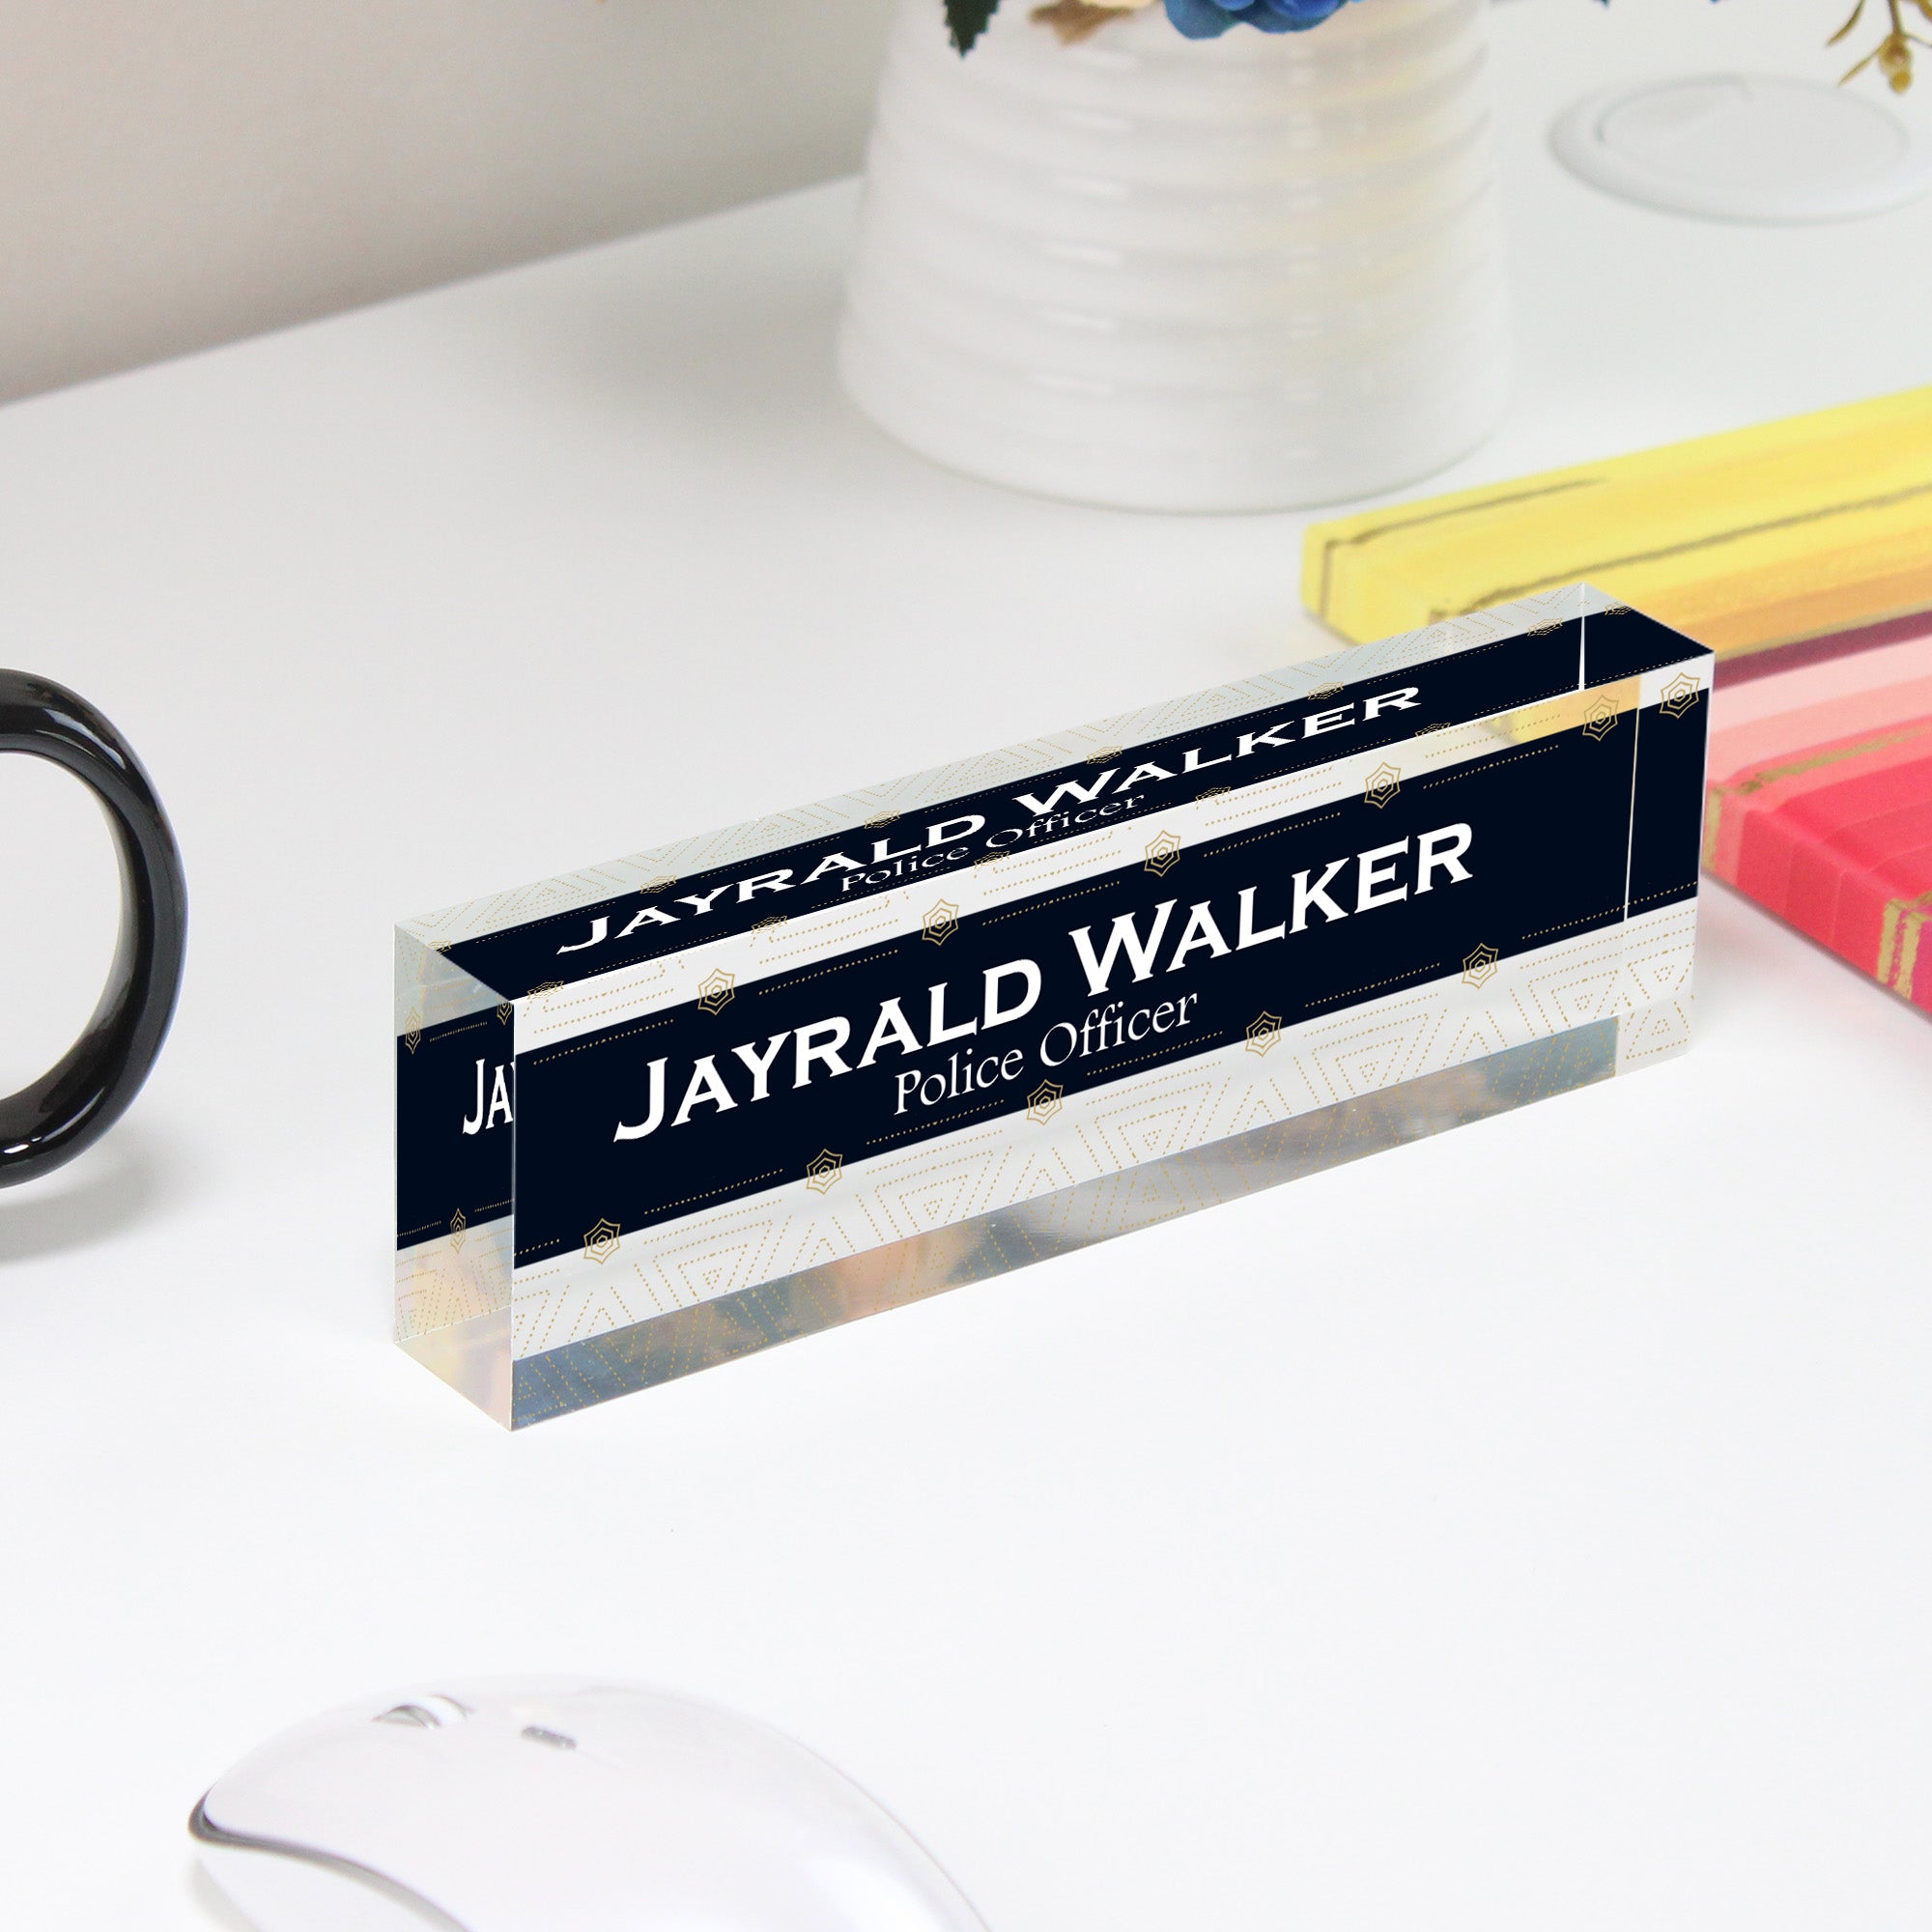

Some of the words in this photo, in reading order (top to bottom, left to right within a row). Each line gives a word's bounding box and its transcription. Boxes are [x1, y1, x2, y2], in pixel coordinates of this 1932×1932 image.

[555, 814, 985, 955] JAYRALD
[1011, 687, 1422, 817] WALKER
[841, 846, 970, 893] Police
[985, 794, 1146, 848] Officer
[612, 958, 1041, 1143] JAYRALD
[1067, 822, 1473, 997] WALKER
[462, 1058, 515, 1135] JA
[894, 1047, 1024, 1116] Police
[1039, 993, 1198, 1066] Officer
